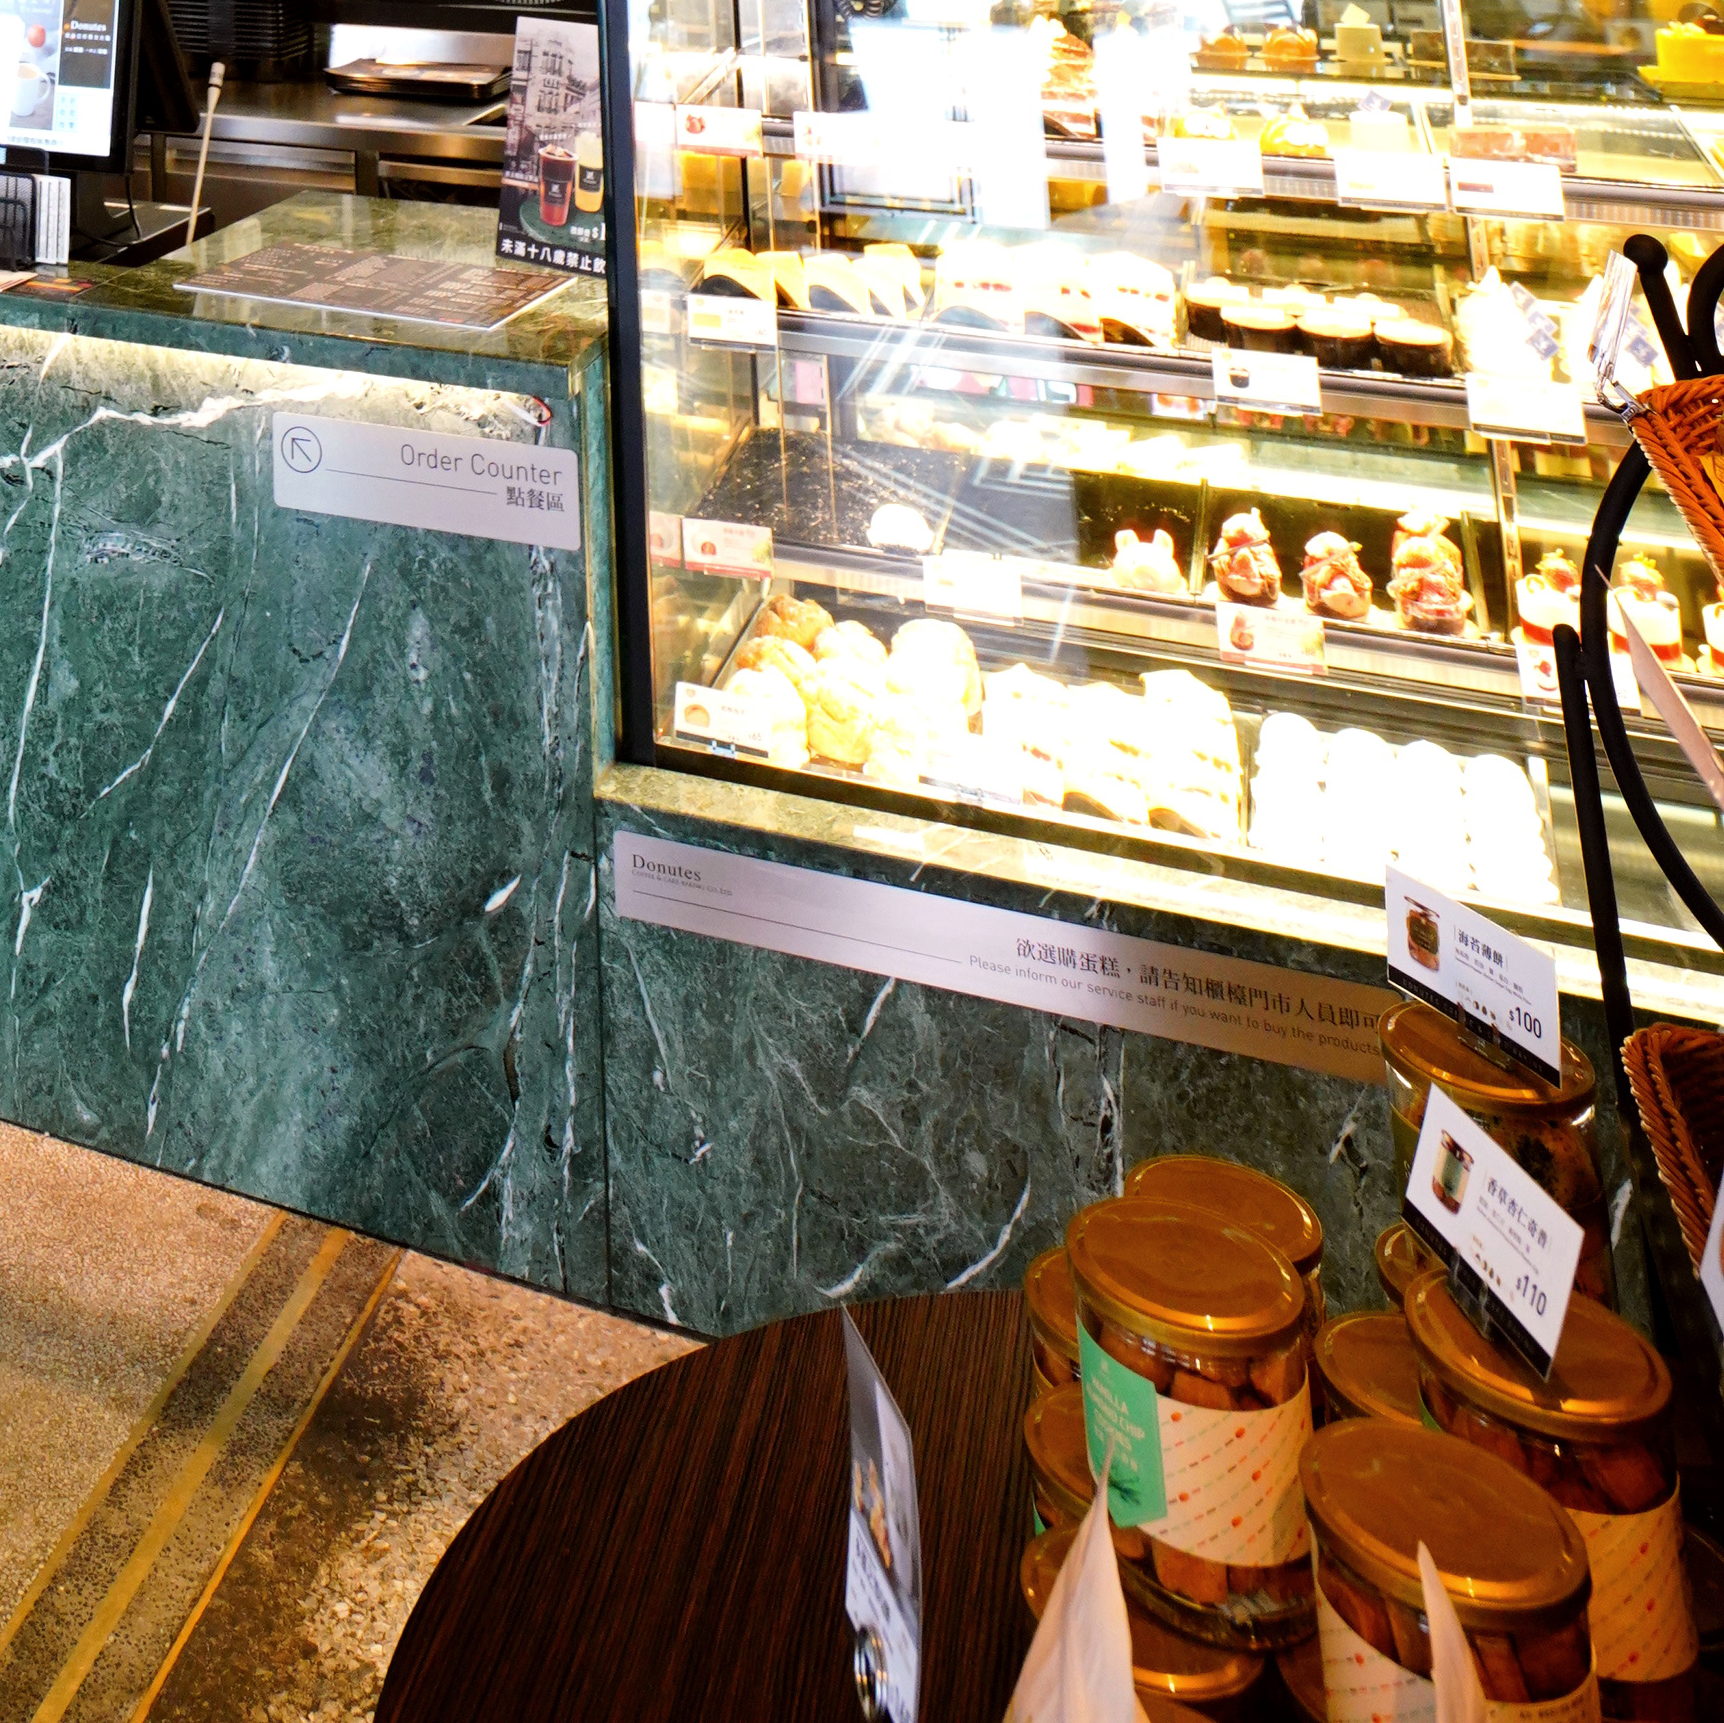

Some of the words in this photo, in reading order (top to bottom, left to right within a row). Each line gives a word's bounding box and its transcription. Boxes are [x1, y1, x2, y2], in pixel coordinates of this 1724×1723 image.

[70, 20, 107, 32] Donutes
[500, 237, 607, 275] 未滿十八歲禁止飲
[400, 443, 463, 473] Order
[470, 453, 563, 486] Counter
[505, 486, 565, 513] 點餐區
[632, 853, 702, 882] Donutes
[1458, 928, 1504, 969] 海苔薄餅
[970, 955, 1011, 976] Please
[1014, 963, 1058, 986] inform
[1061, 976, 1084, 990] our
[1087, 982, 1133, 1002] service
[1137, 994, 1166, 1010] staff
[1170, 999, 1178, 1012] if
[1182, 1003, 1206, 1018] you
[1210, 1010, 1243, 1026] want
[1246, 1016, 1260, 1030] to
[1264, 1019, 1287, 1037] buy
[1291, 1027, 1315, 1041] the
[1319, 1033, 1381, 1056] products
[1508, 1006, 1542, 1039] $100
[1516, 1274, 1548, 1317] $110
